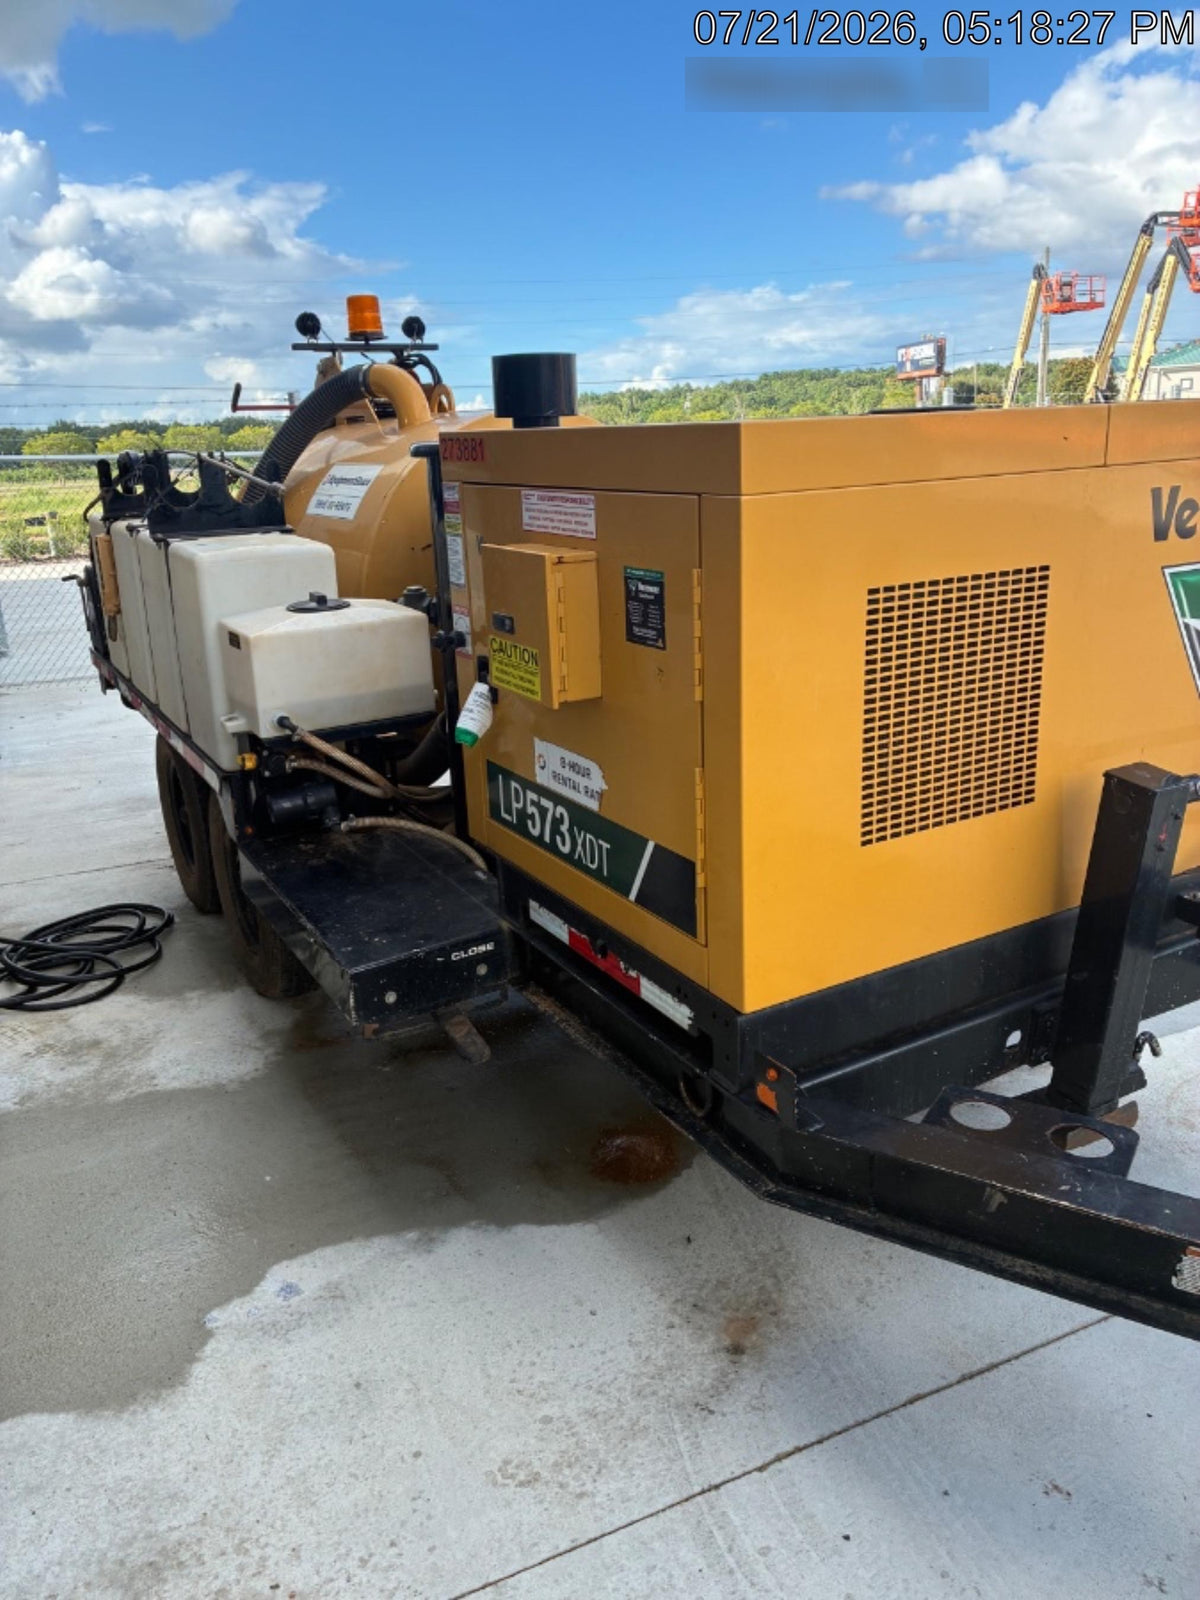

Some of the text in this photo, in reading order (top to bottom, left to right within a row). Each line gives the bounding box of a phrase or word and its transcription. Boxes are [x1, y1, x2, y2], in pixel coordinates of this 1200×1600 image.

[440, 437, 485, 462] 273881
[1151, 485, 1200, 543] Ve
[490, 637, 539, 667] CAUTION
[560, 756, 593, 780] 8-HOUR
[551, 770, 582, 794] RENTAL
[451, 942, 495, 961] CLOSE
